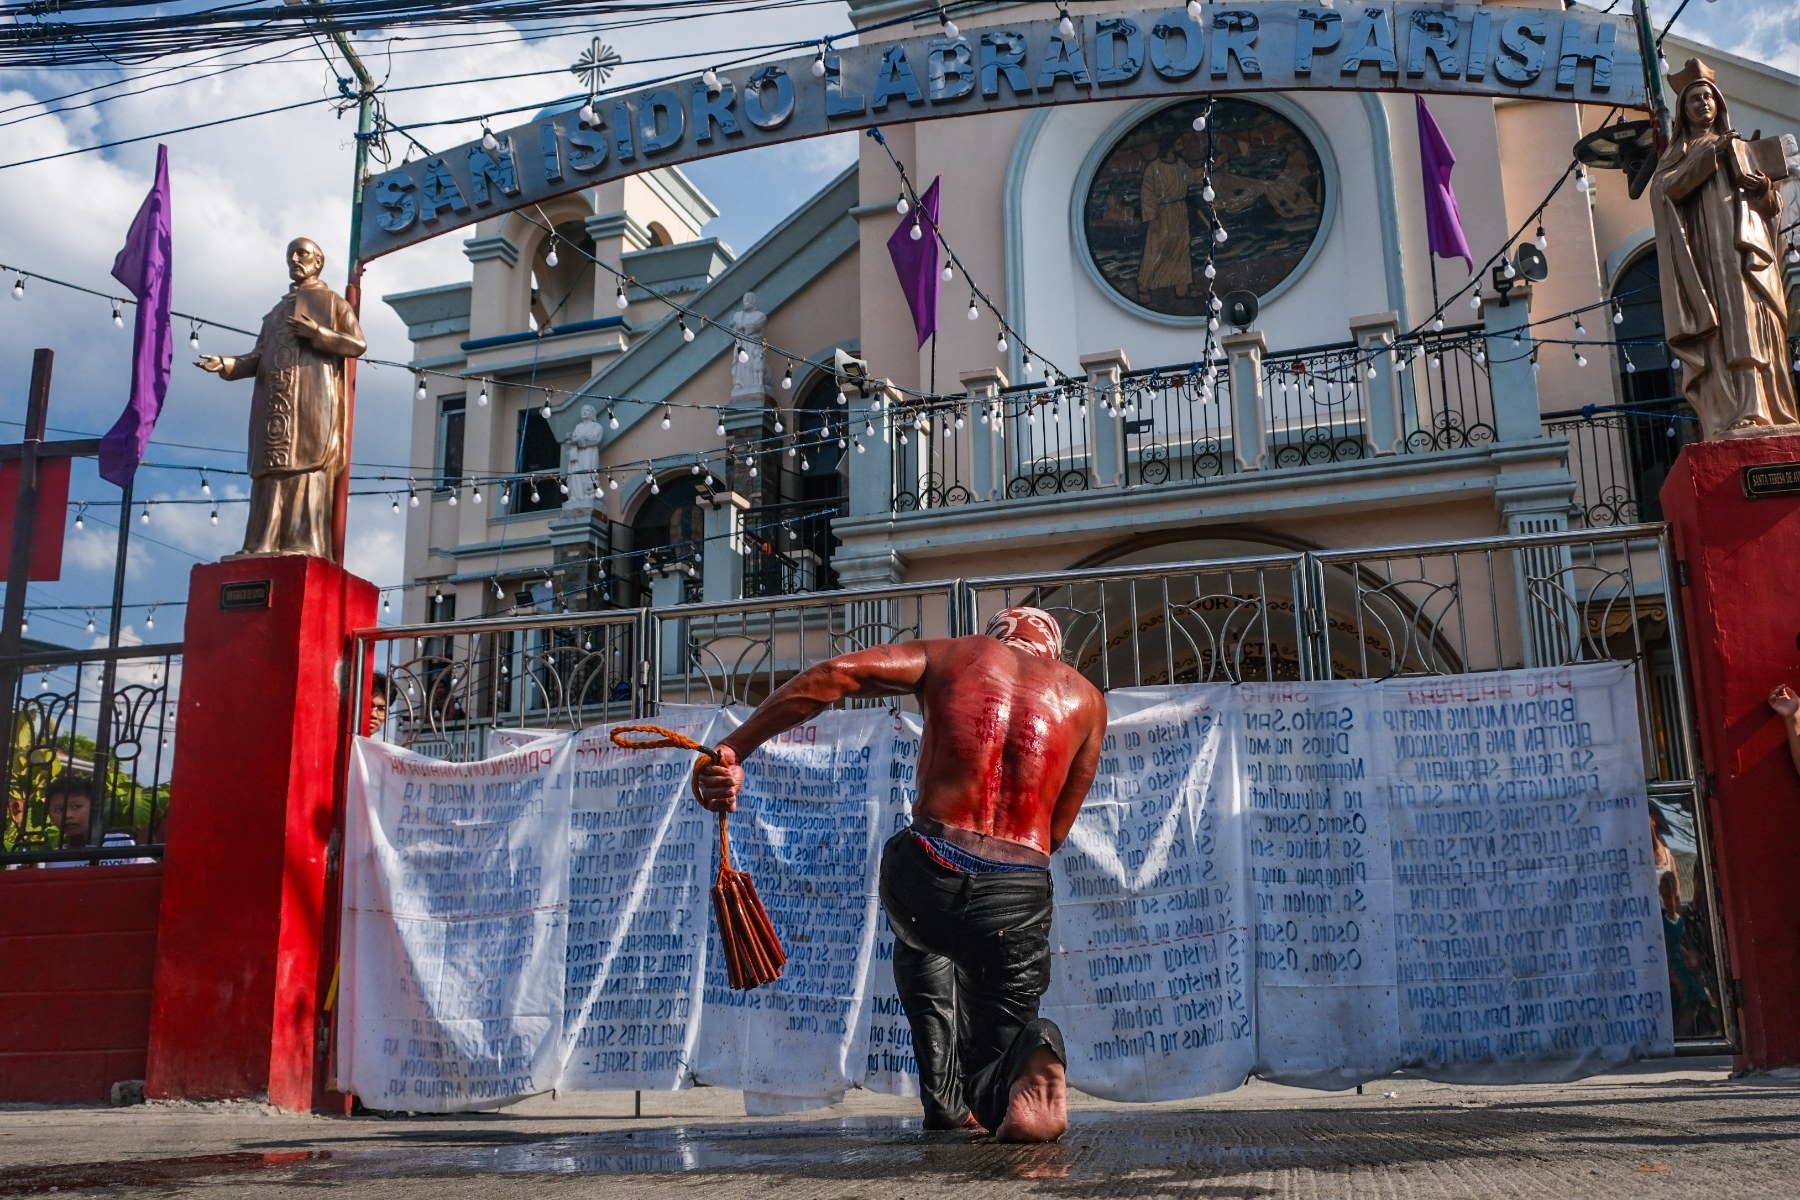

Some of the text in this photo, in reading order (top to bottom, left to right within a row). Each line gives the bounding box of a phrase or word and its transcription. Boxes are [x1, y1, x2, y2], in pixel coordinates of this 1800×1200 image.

[376, 8, 1618, 233] SAN ISIDRO LABRADOR PARISH
